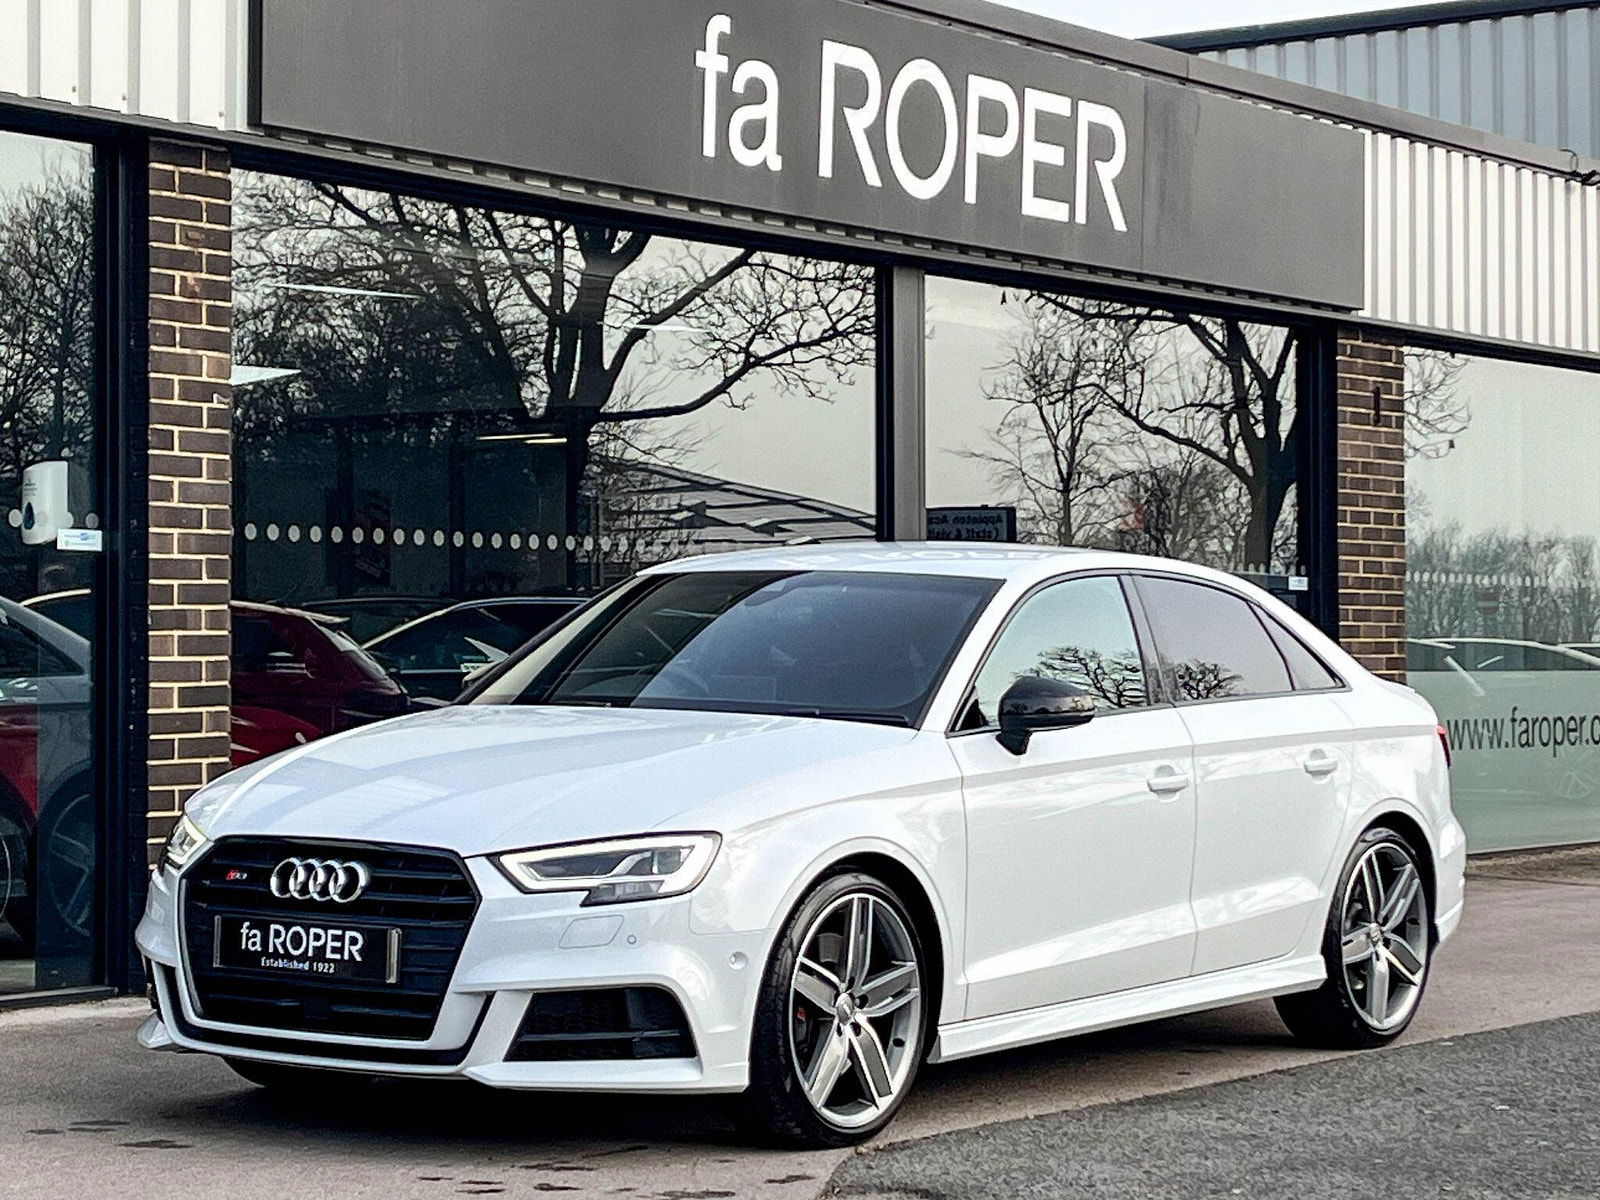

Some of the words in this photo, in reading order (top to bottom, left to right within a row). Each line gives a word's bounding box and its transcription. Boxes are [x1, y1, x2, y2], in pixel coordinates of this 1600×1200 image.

[695, 14, 783, 171] fa
[817, 39, 1128, 232] ROPER
[240, 921, 263, 952] fa
[268, 923, 364, 962] ROPER
[260, 956, 310, 971] Established
